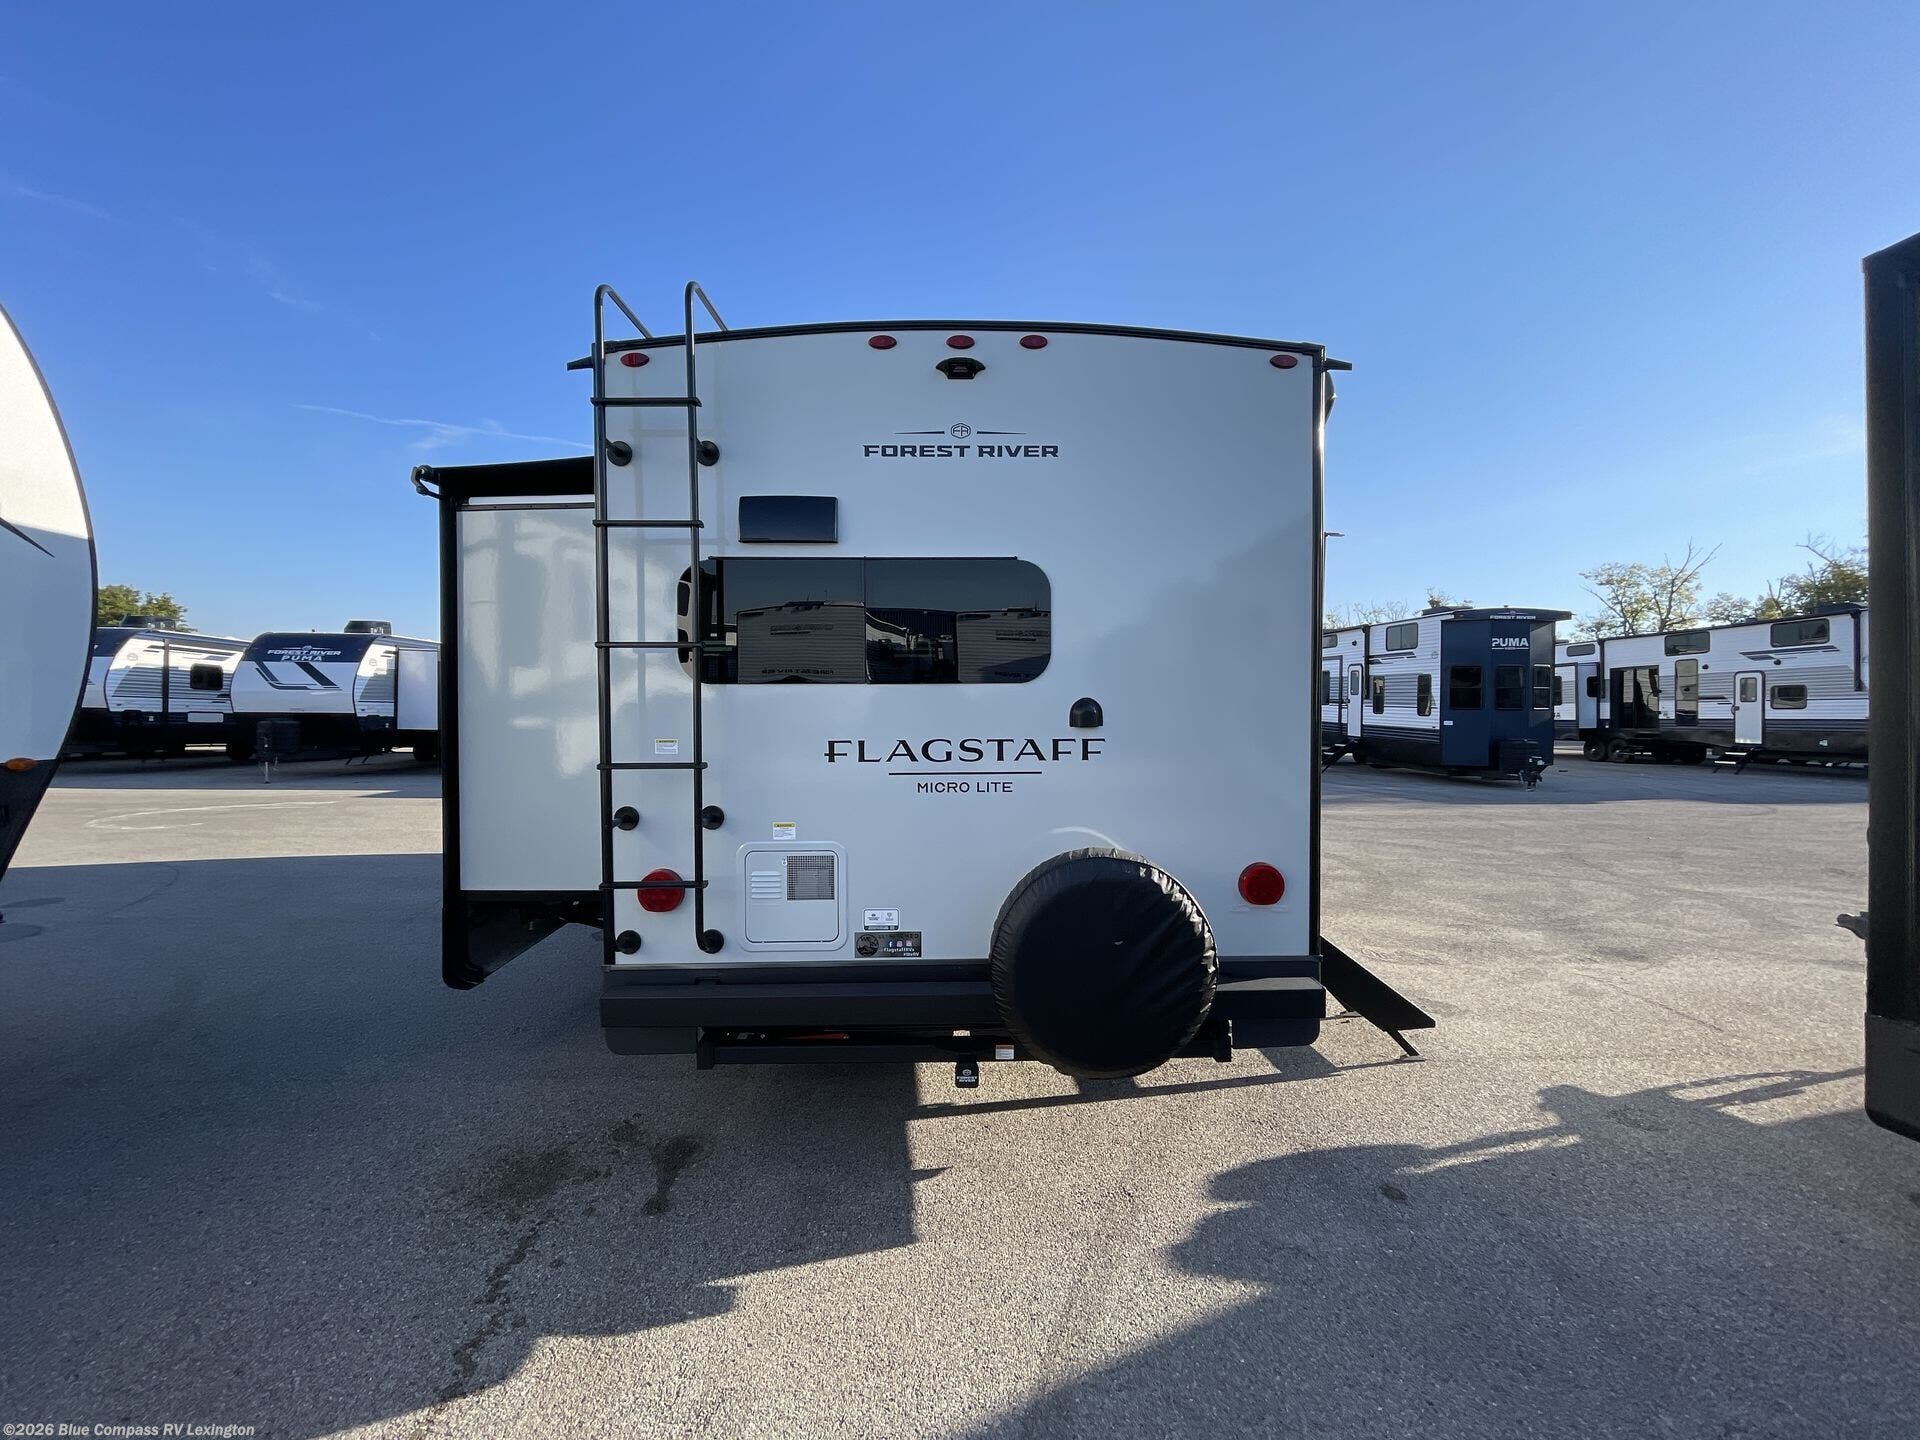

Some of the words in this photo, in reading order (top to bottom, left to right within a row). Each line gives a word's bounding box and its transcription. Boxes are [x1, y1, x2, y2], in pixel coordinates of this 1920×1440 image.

[863, 444, 971, 457] FOREST
[978, 444, 1059, 457] RIVER
[1491, 637, 1529, 647] PUMA
[824, 737, 1106, 763] FLAGSTAFF
[917, 781, 970, 793] MICRO
[976, 781, 1013, 793] LITE
